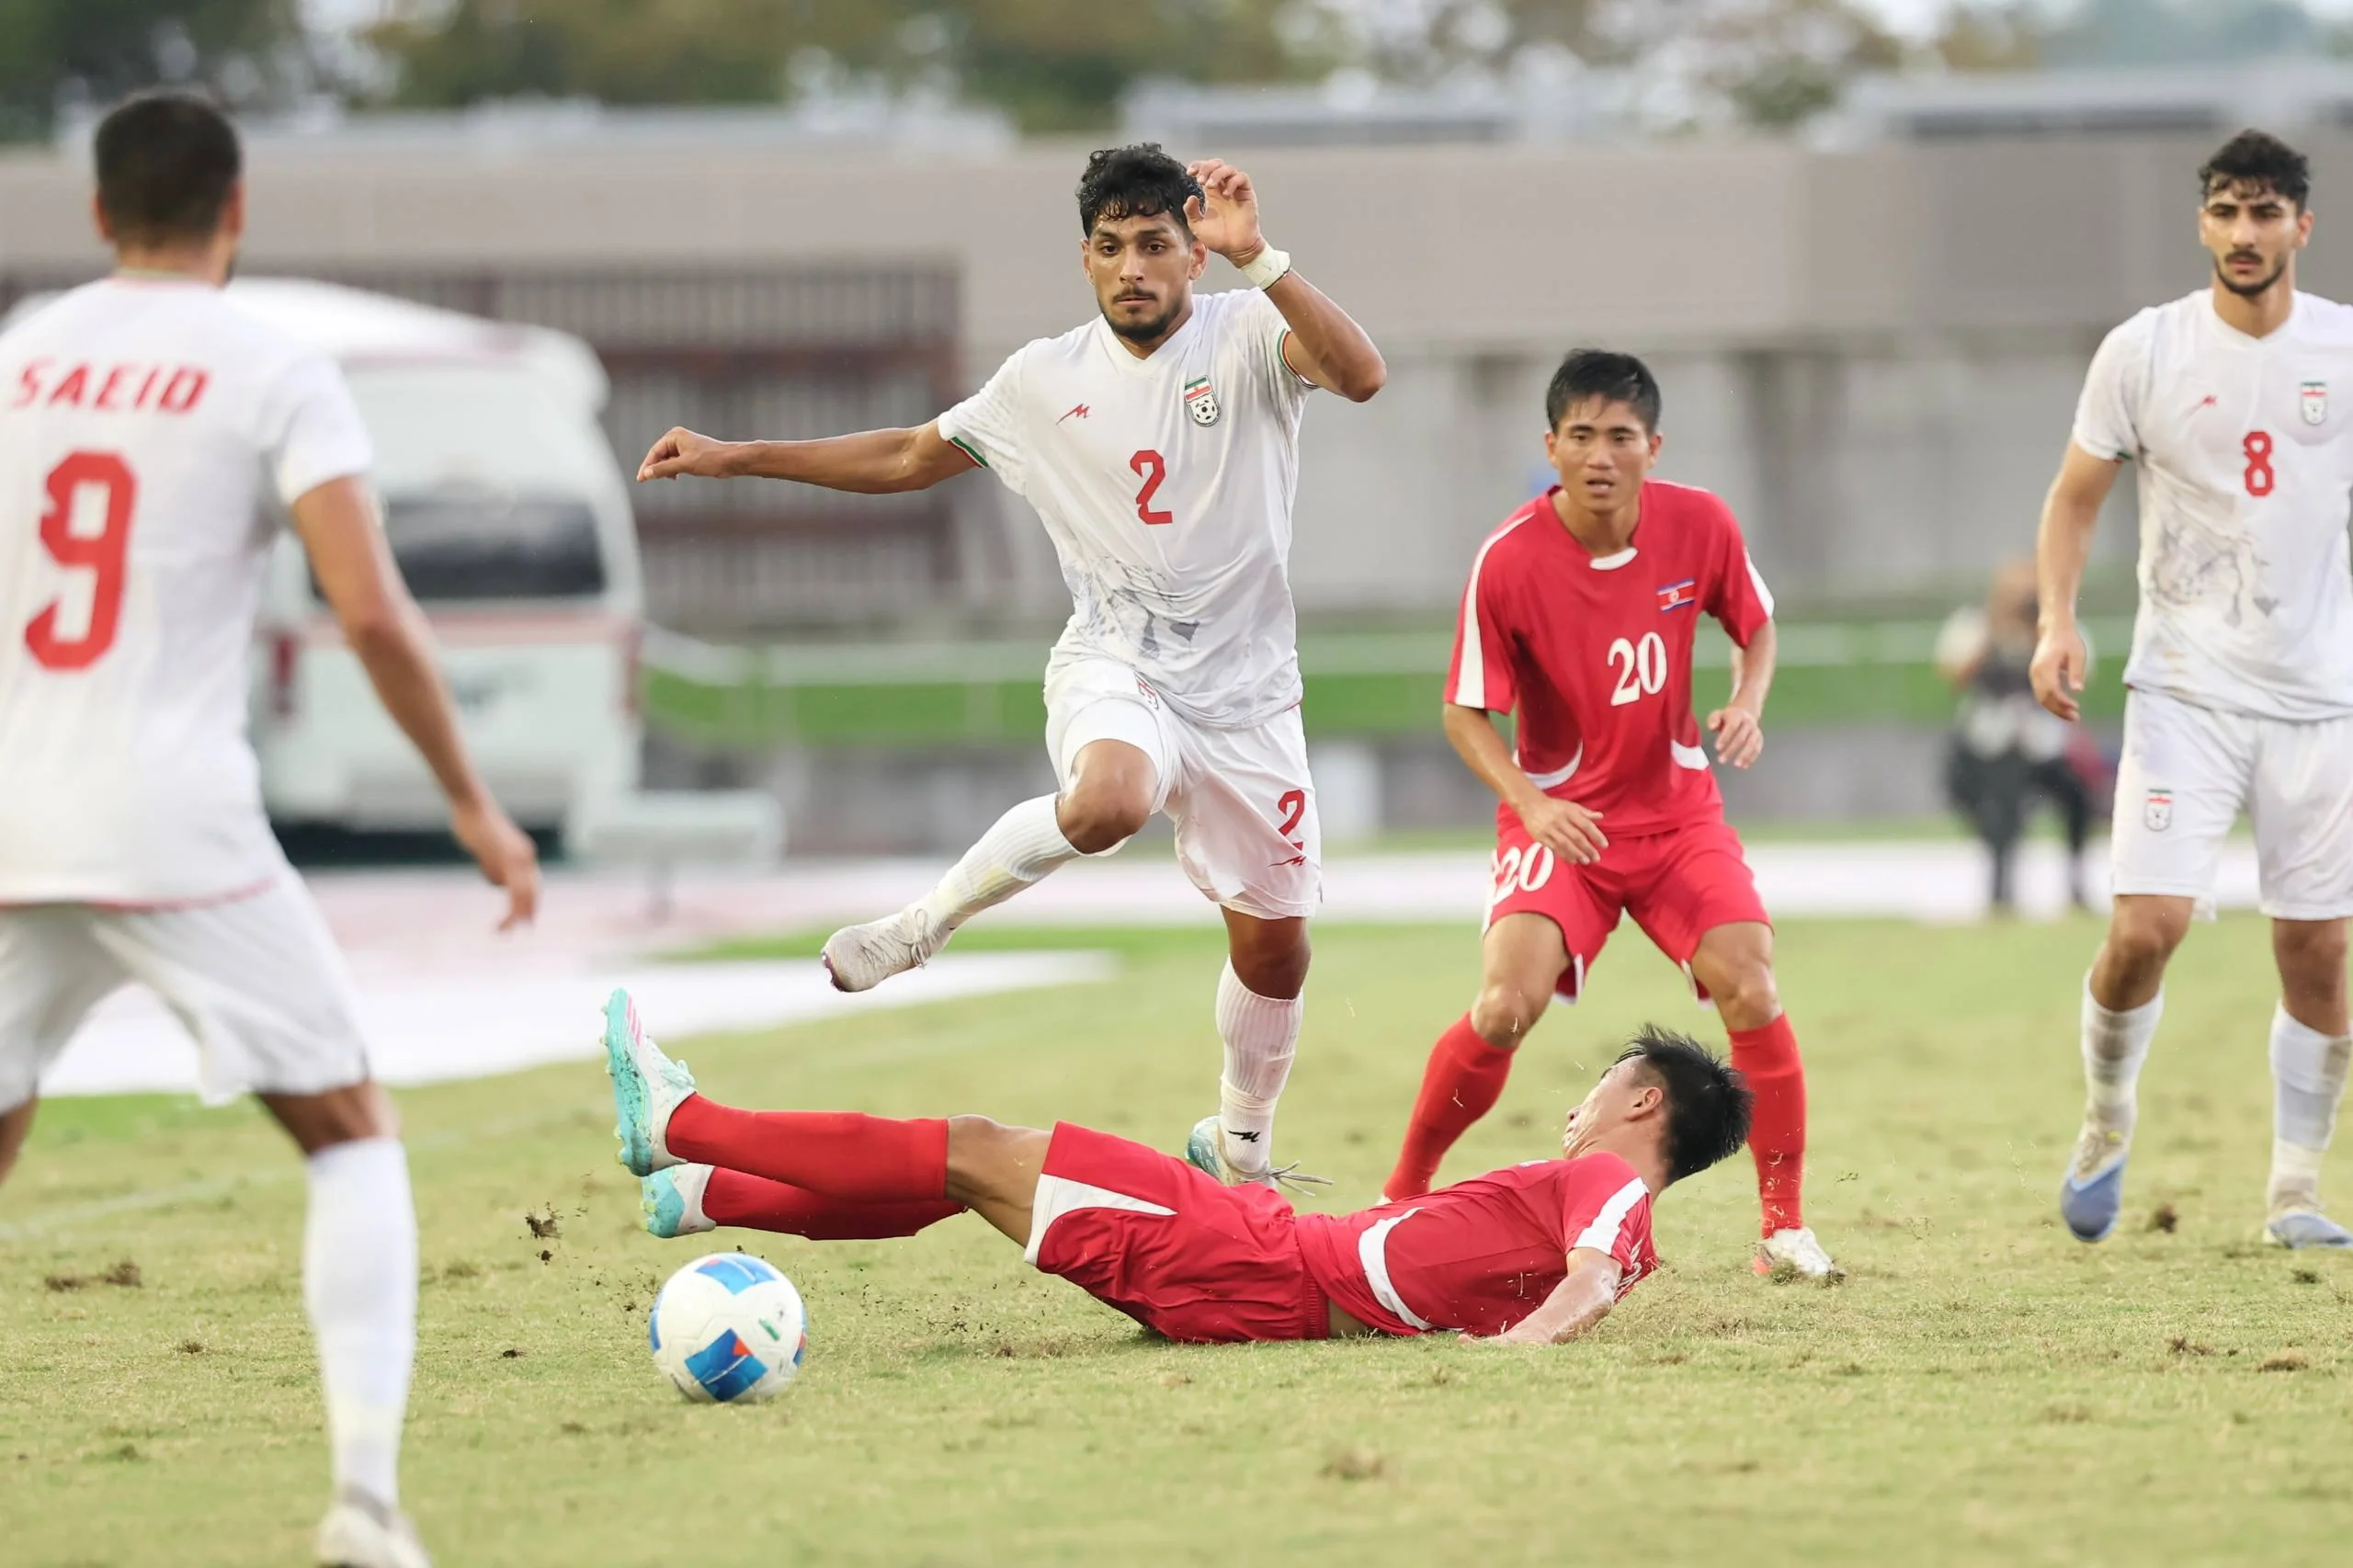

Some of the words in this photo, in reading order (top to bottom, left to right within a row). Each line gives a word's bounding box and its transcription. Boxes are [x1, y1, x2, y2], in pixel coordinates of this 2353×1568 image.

[11, 357, 212, 415] SAEID
[1130, 449, 1174, 525] 2
[2243, 430, 2274, 496] 8
[24, 449, 138, 671] 9
[1607, 631, 1667, 706] 20
[1278, 789, 1305, 852] 2
[1488, 841, 1555, 906] 20
